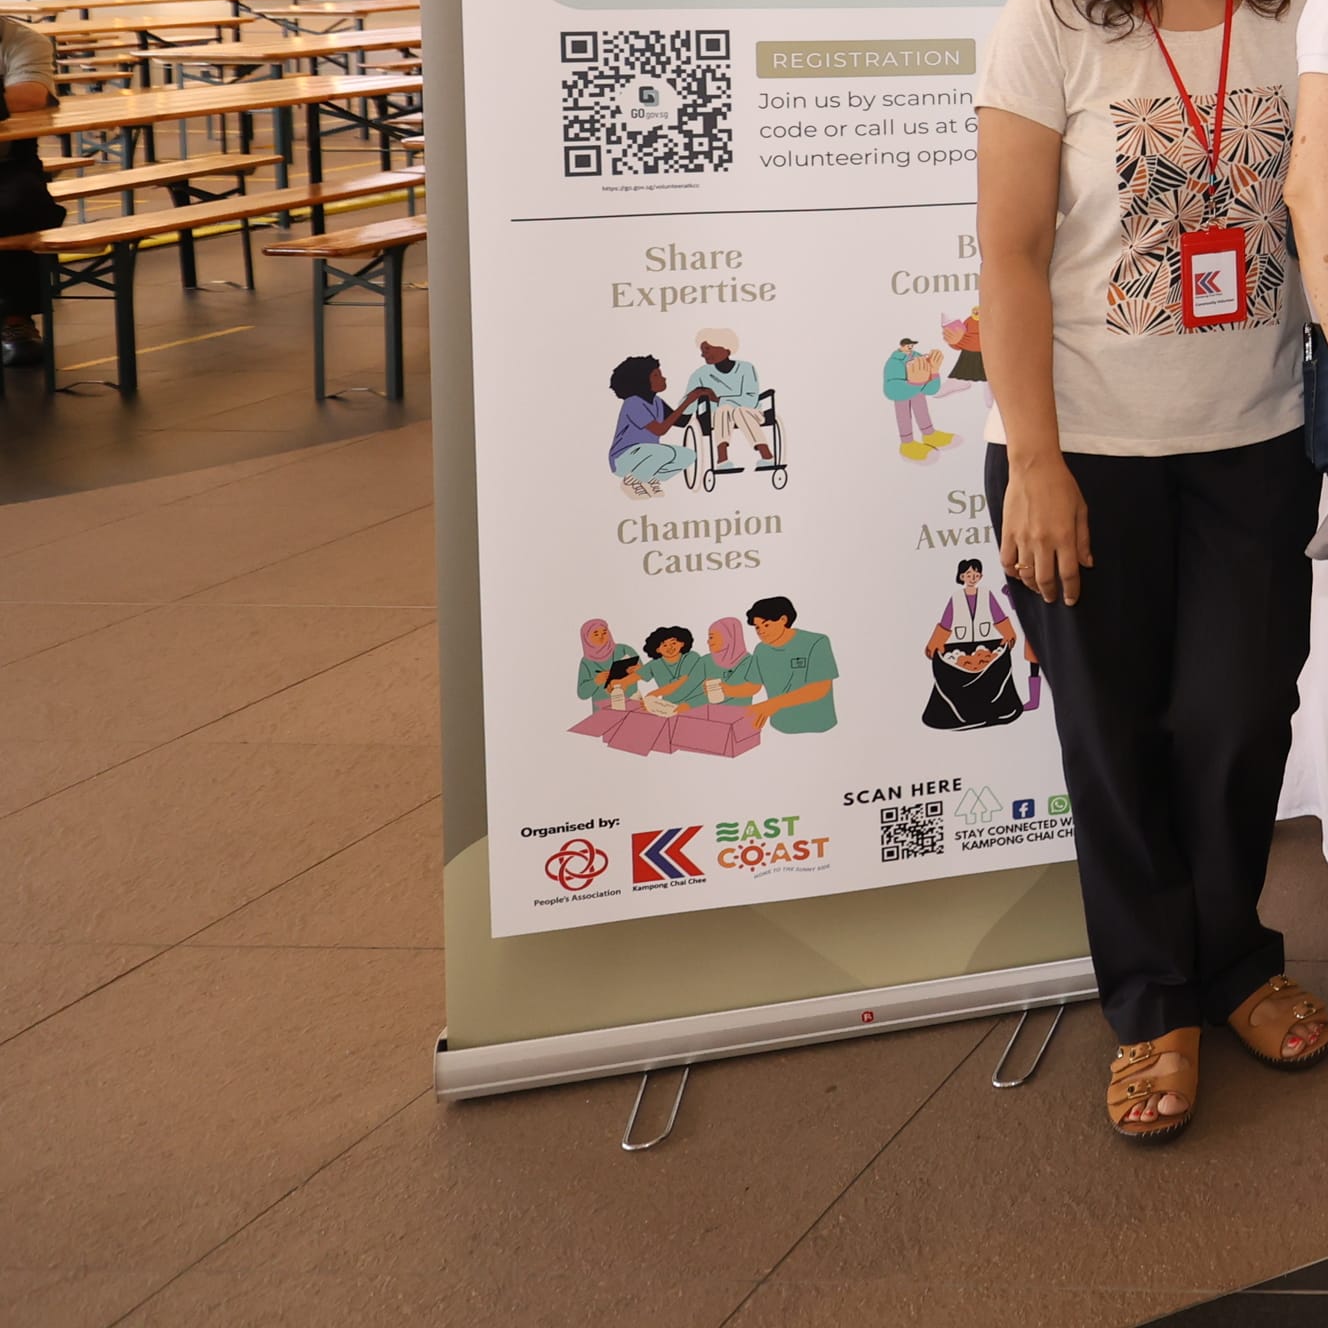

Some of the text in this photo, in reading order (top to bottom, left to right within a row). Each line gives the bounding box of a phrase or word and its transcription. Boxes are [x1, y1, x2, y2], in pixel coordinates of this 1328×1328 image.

[772, 50, 961, 70] REGISTRATION
[758, 88, 974, 113] Join us by scannin
[759, 118, 958, 139] code or call us at
[759, 145, 979, 169] volunteering oppo
[643, 244, 744, 273] Share
[610, 276, 777, 310] Expertise
[616, 510, 784, 547] Champion
[641, 546, 762, 577] Causes
[843, 777, 963, 807] SCAN HERE
[520, 817, 621, 839] Organised by:
[715, 815, 800, 844] EAST
[954, 819, 1057, 841] STAY CONNECTED
[961, 830, 1055, 852] KAMPONG CHAI
[716, 837, 830, 872] COAST
[632, 877, 708, 893] Kampong Chai Chee
[533, 888, 622, 908] People's Association
